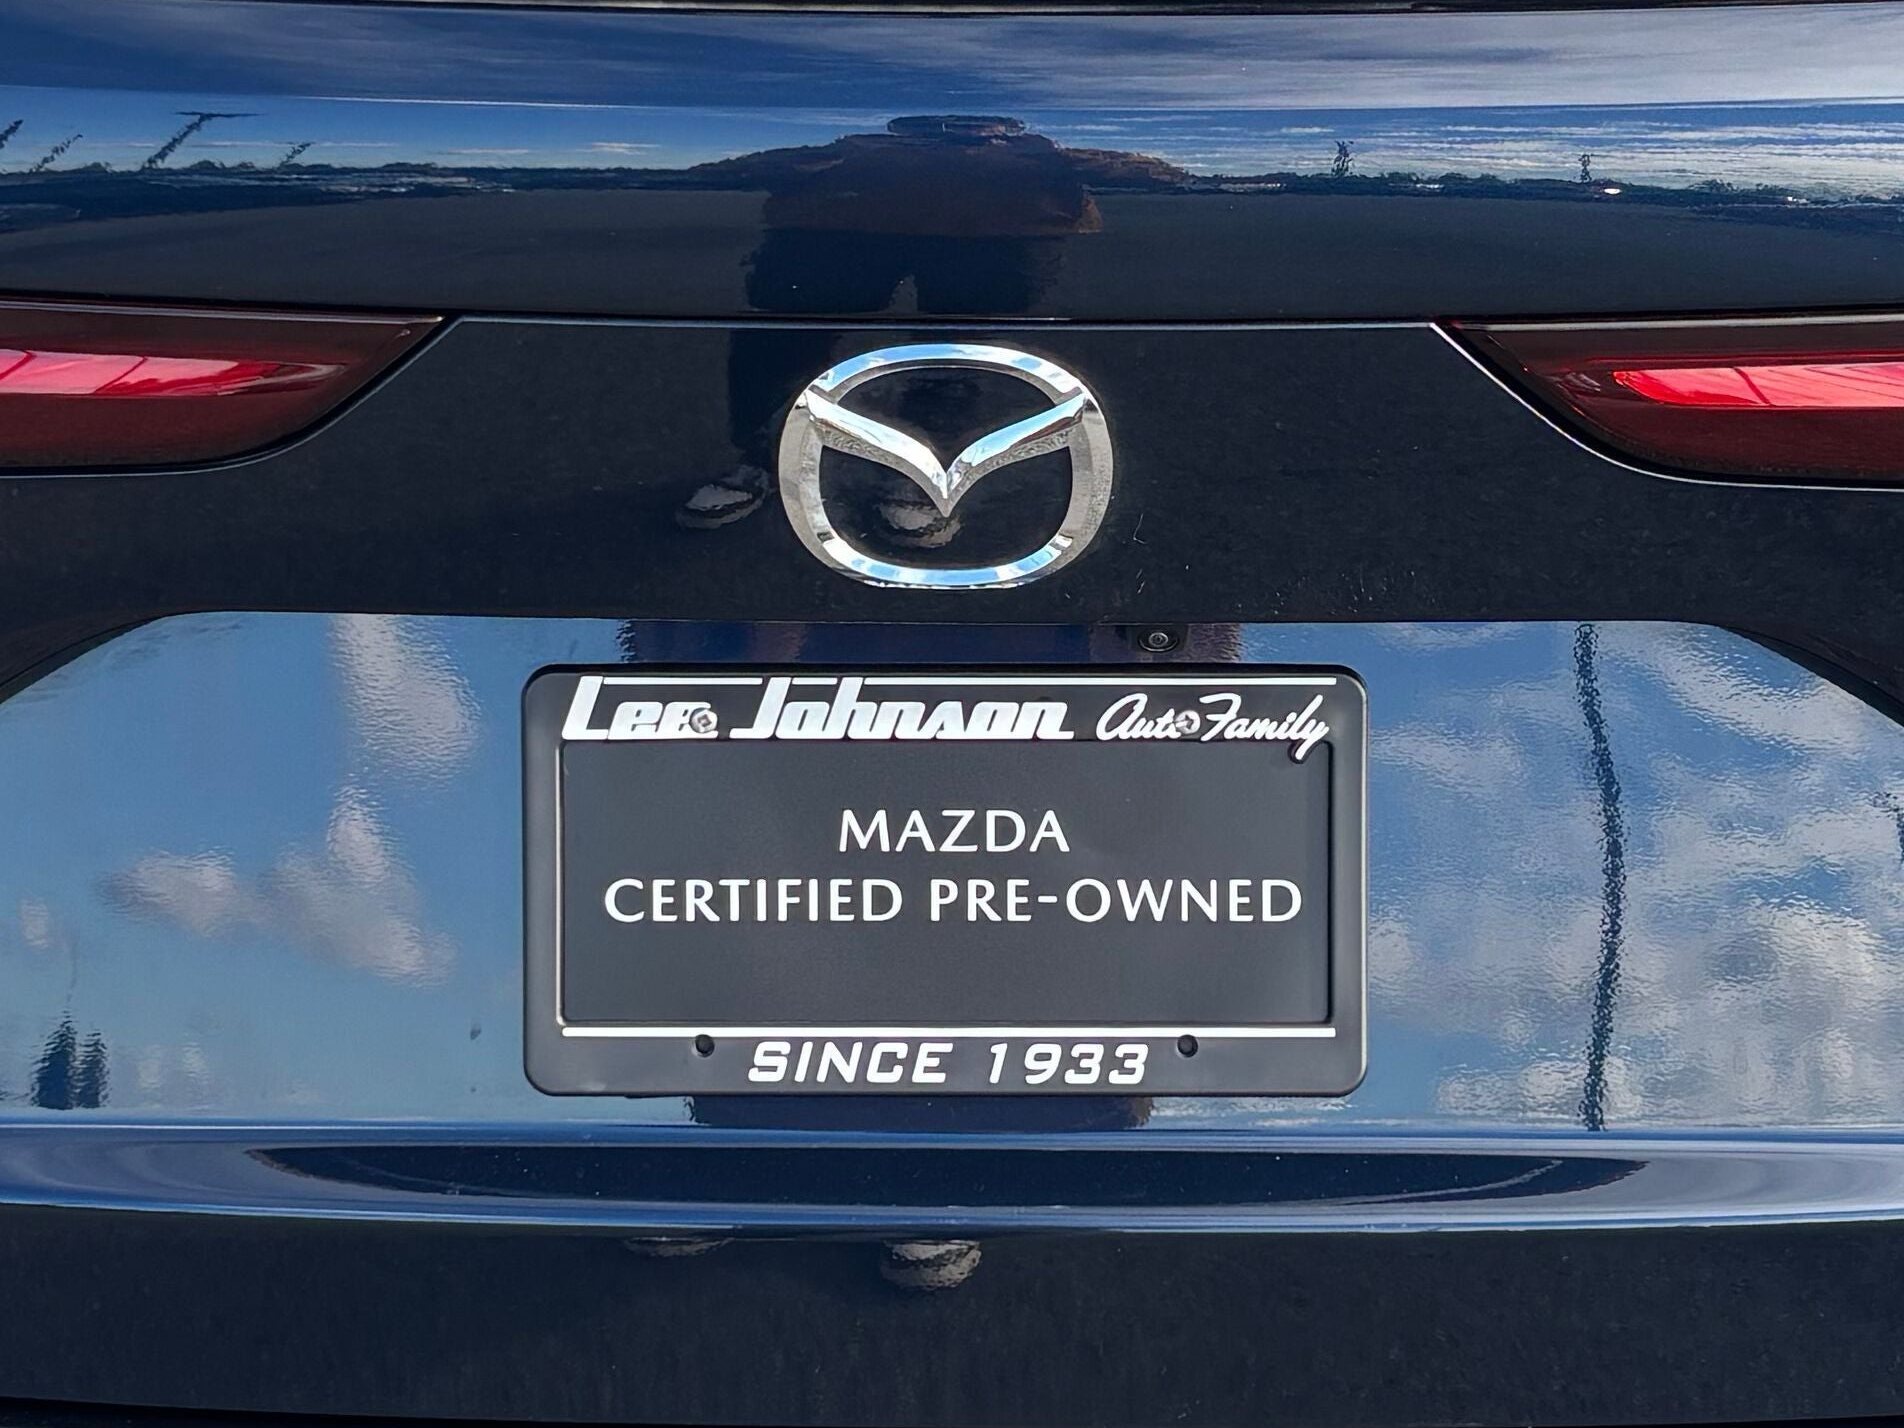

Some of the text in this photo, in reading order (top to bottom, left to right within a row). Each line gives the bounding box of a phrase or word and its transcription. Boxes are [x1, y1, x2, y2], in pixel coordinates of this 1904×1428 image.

[561, 675, 1329, 760] Lee Johnson Aut Family
[839, 809, 1070, 853] MAZDA
[604, 878, 1302, 923] CERTIFIED PRE-OWNED
[747, 1041, 1149, 1085] SINCE 1933
